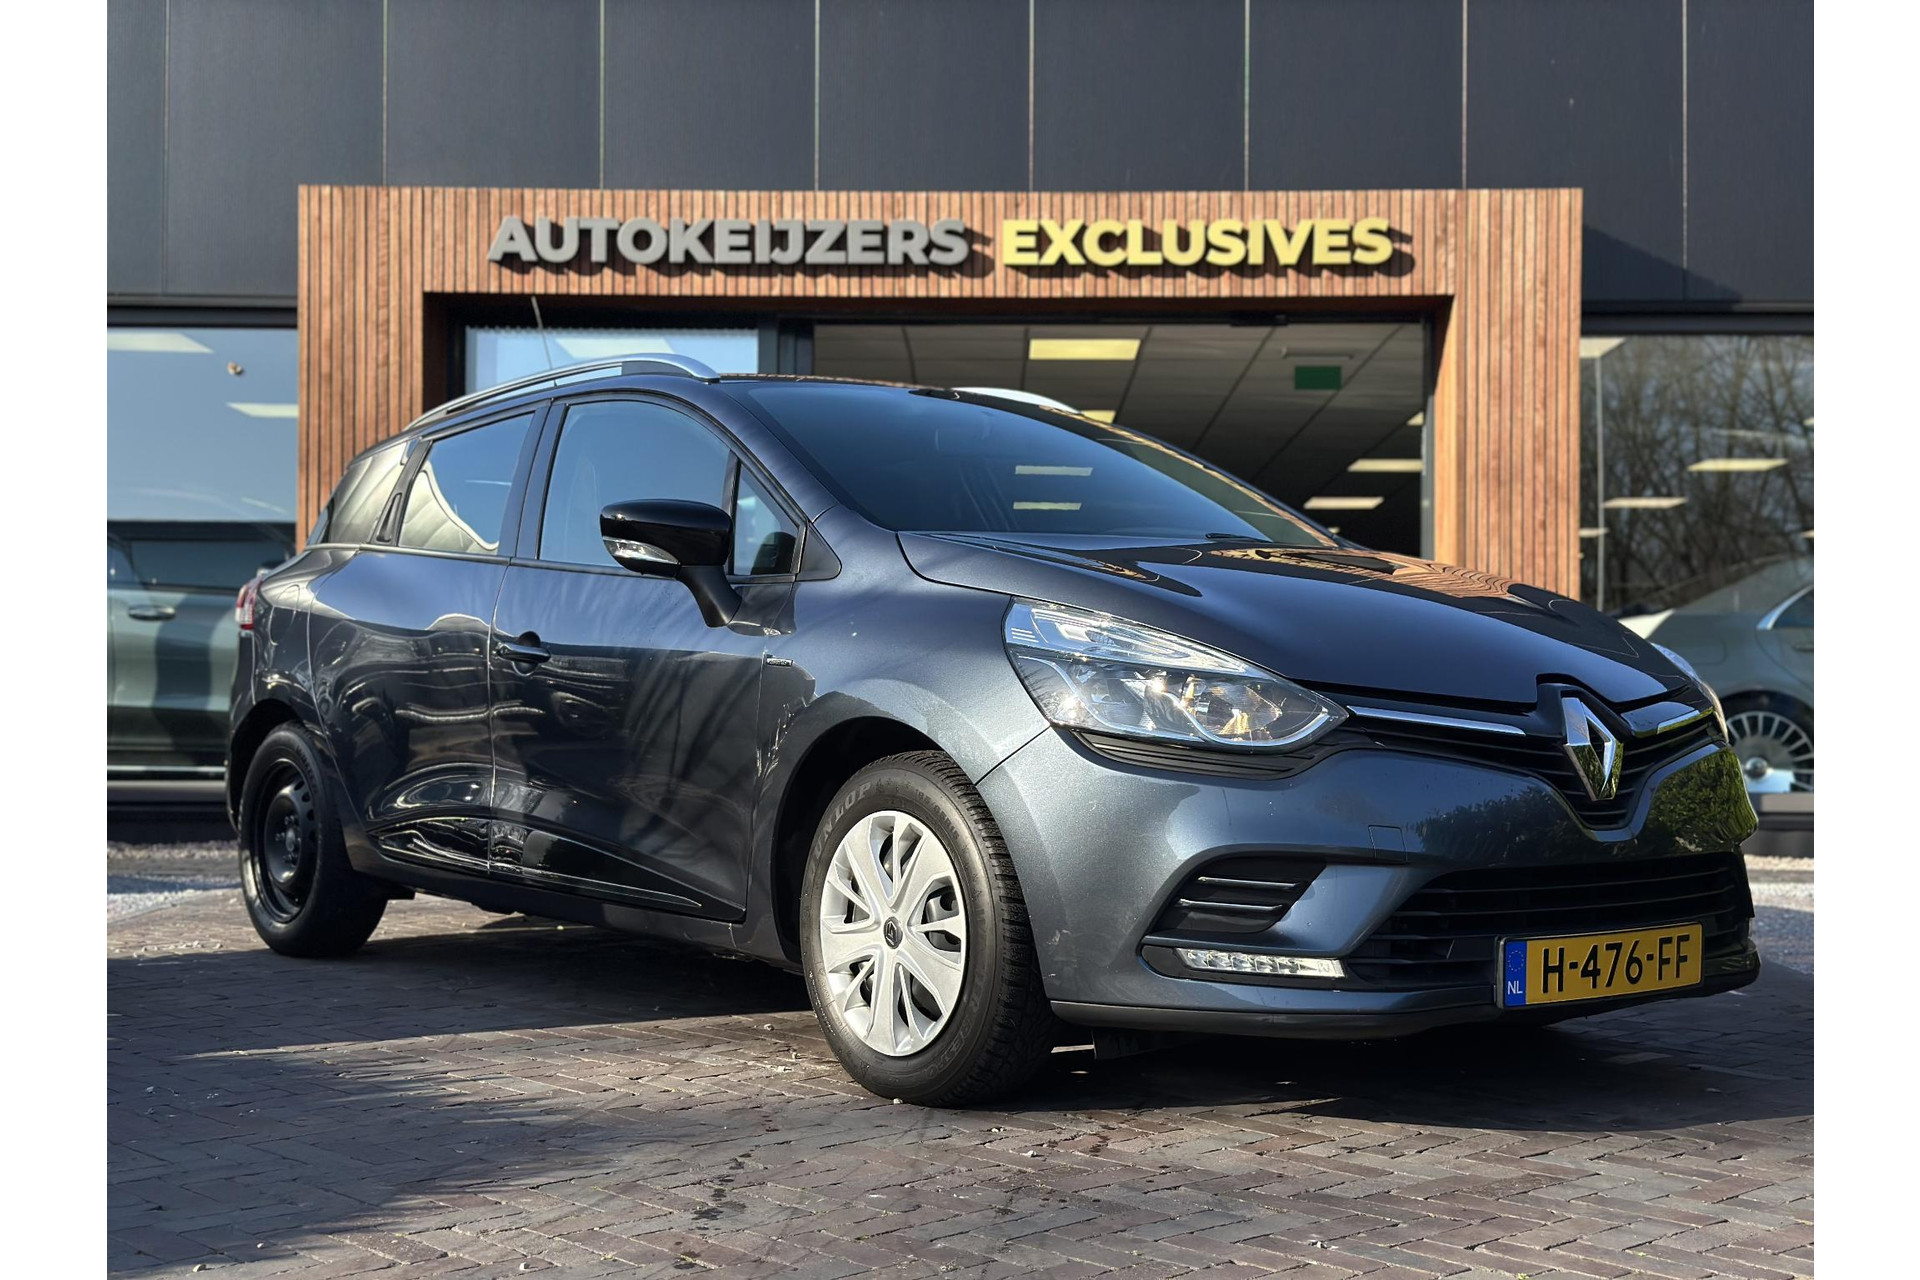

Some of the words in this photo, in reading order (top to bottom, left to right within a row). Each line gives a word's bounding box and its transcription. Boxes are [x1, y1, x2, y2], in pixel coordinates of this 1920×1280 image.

[487, 215, 970, 266] AUTOKEIJZERS
[1002, 217, 1394, 267] EXCLUSIVES
[806, 781, 872, 883] DUNLOP
[1507, 980, 1523, 996] NL
[1541, 933, 1691, 994] H-476-FF
